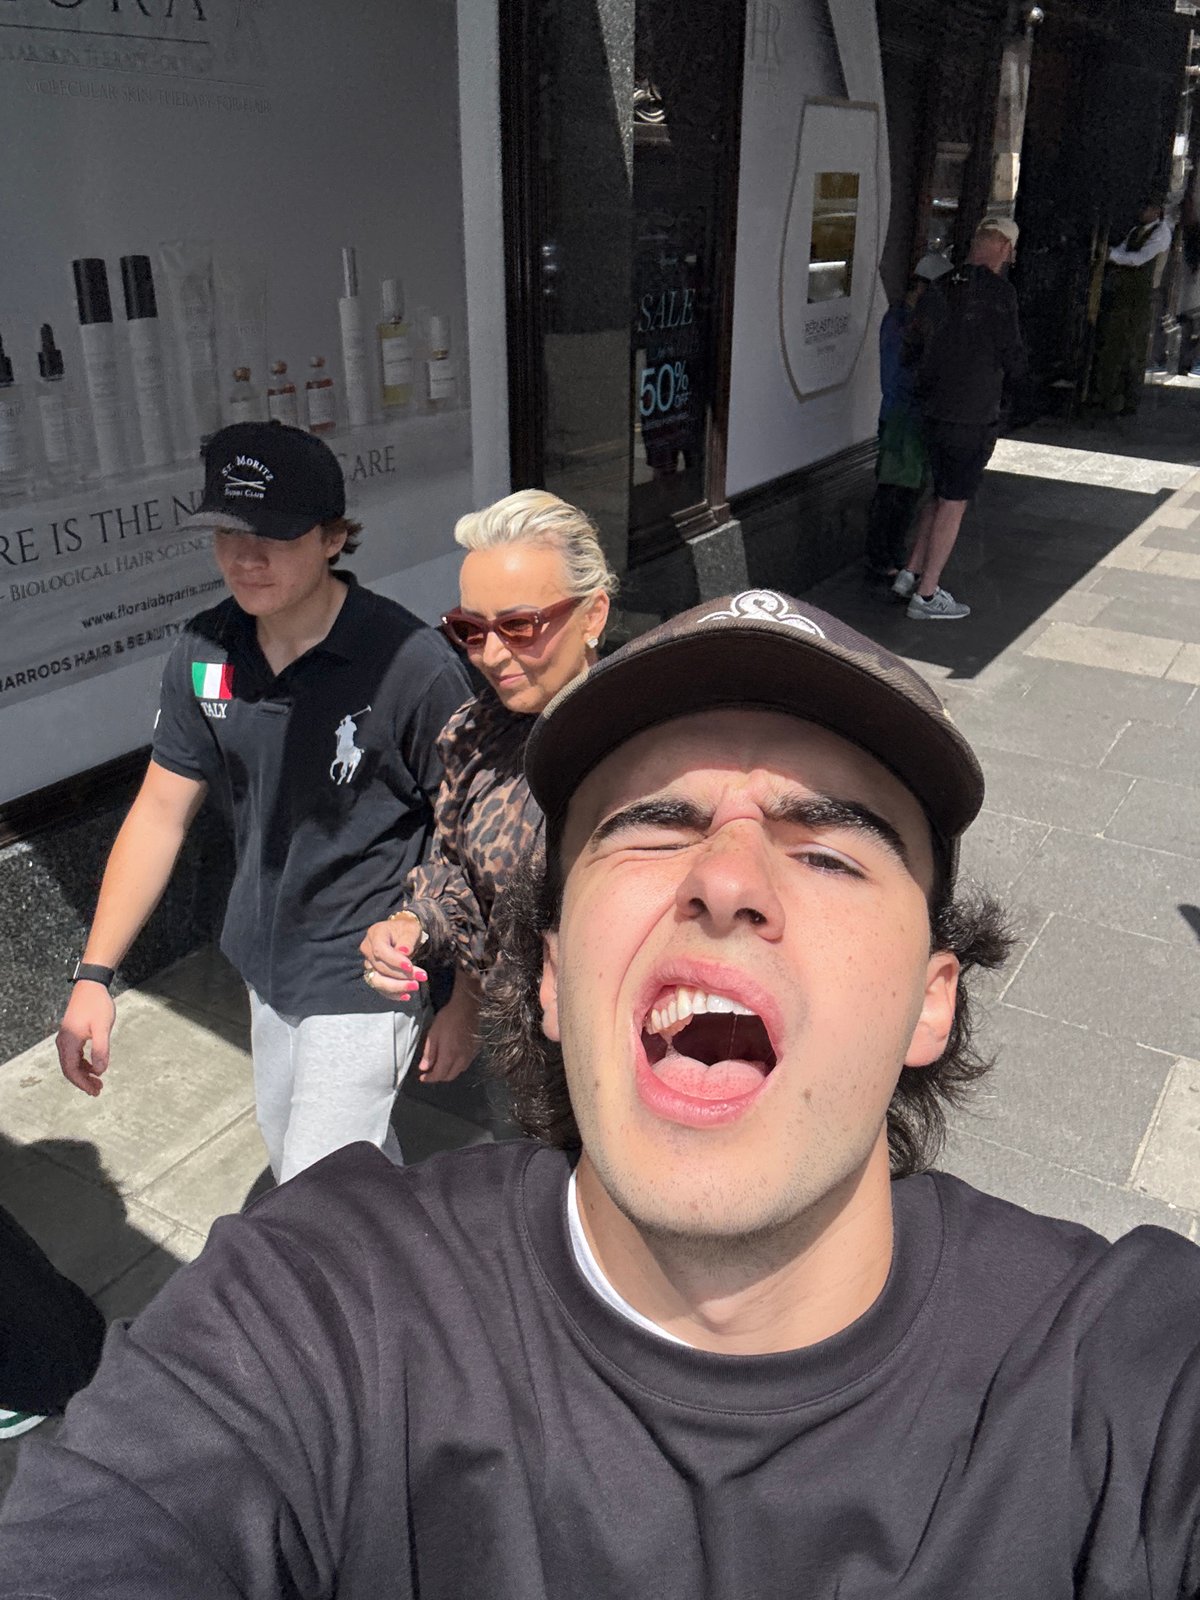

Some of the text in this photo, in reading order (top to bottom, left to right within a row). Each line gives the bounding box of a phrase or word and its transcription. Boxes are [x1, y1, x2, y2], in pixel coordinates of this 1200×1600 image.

[637, 288, 696, 333] SALE
[640, 360, 689, 417] 50%
[48, 517, 83, 556] IS
[89, 499, 164, 544] THE
[9, 562, 112, 602] BIOLOGICAL
[116, 550, 154, 572] HAIR
[74, 644, 112, 667] HAIR
[114, 640, 125, 654] &
[127, 623, 181, 649] BEAUTY
[200, 702, 228, 719] TALY
